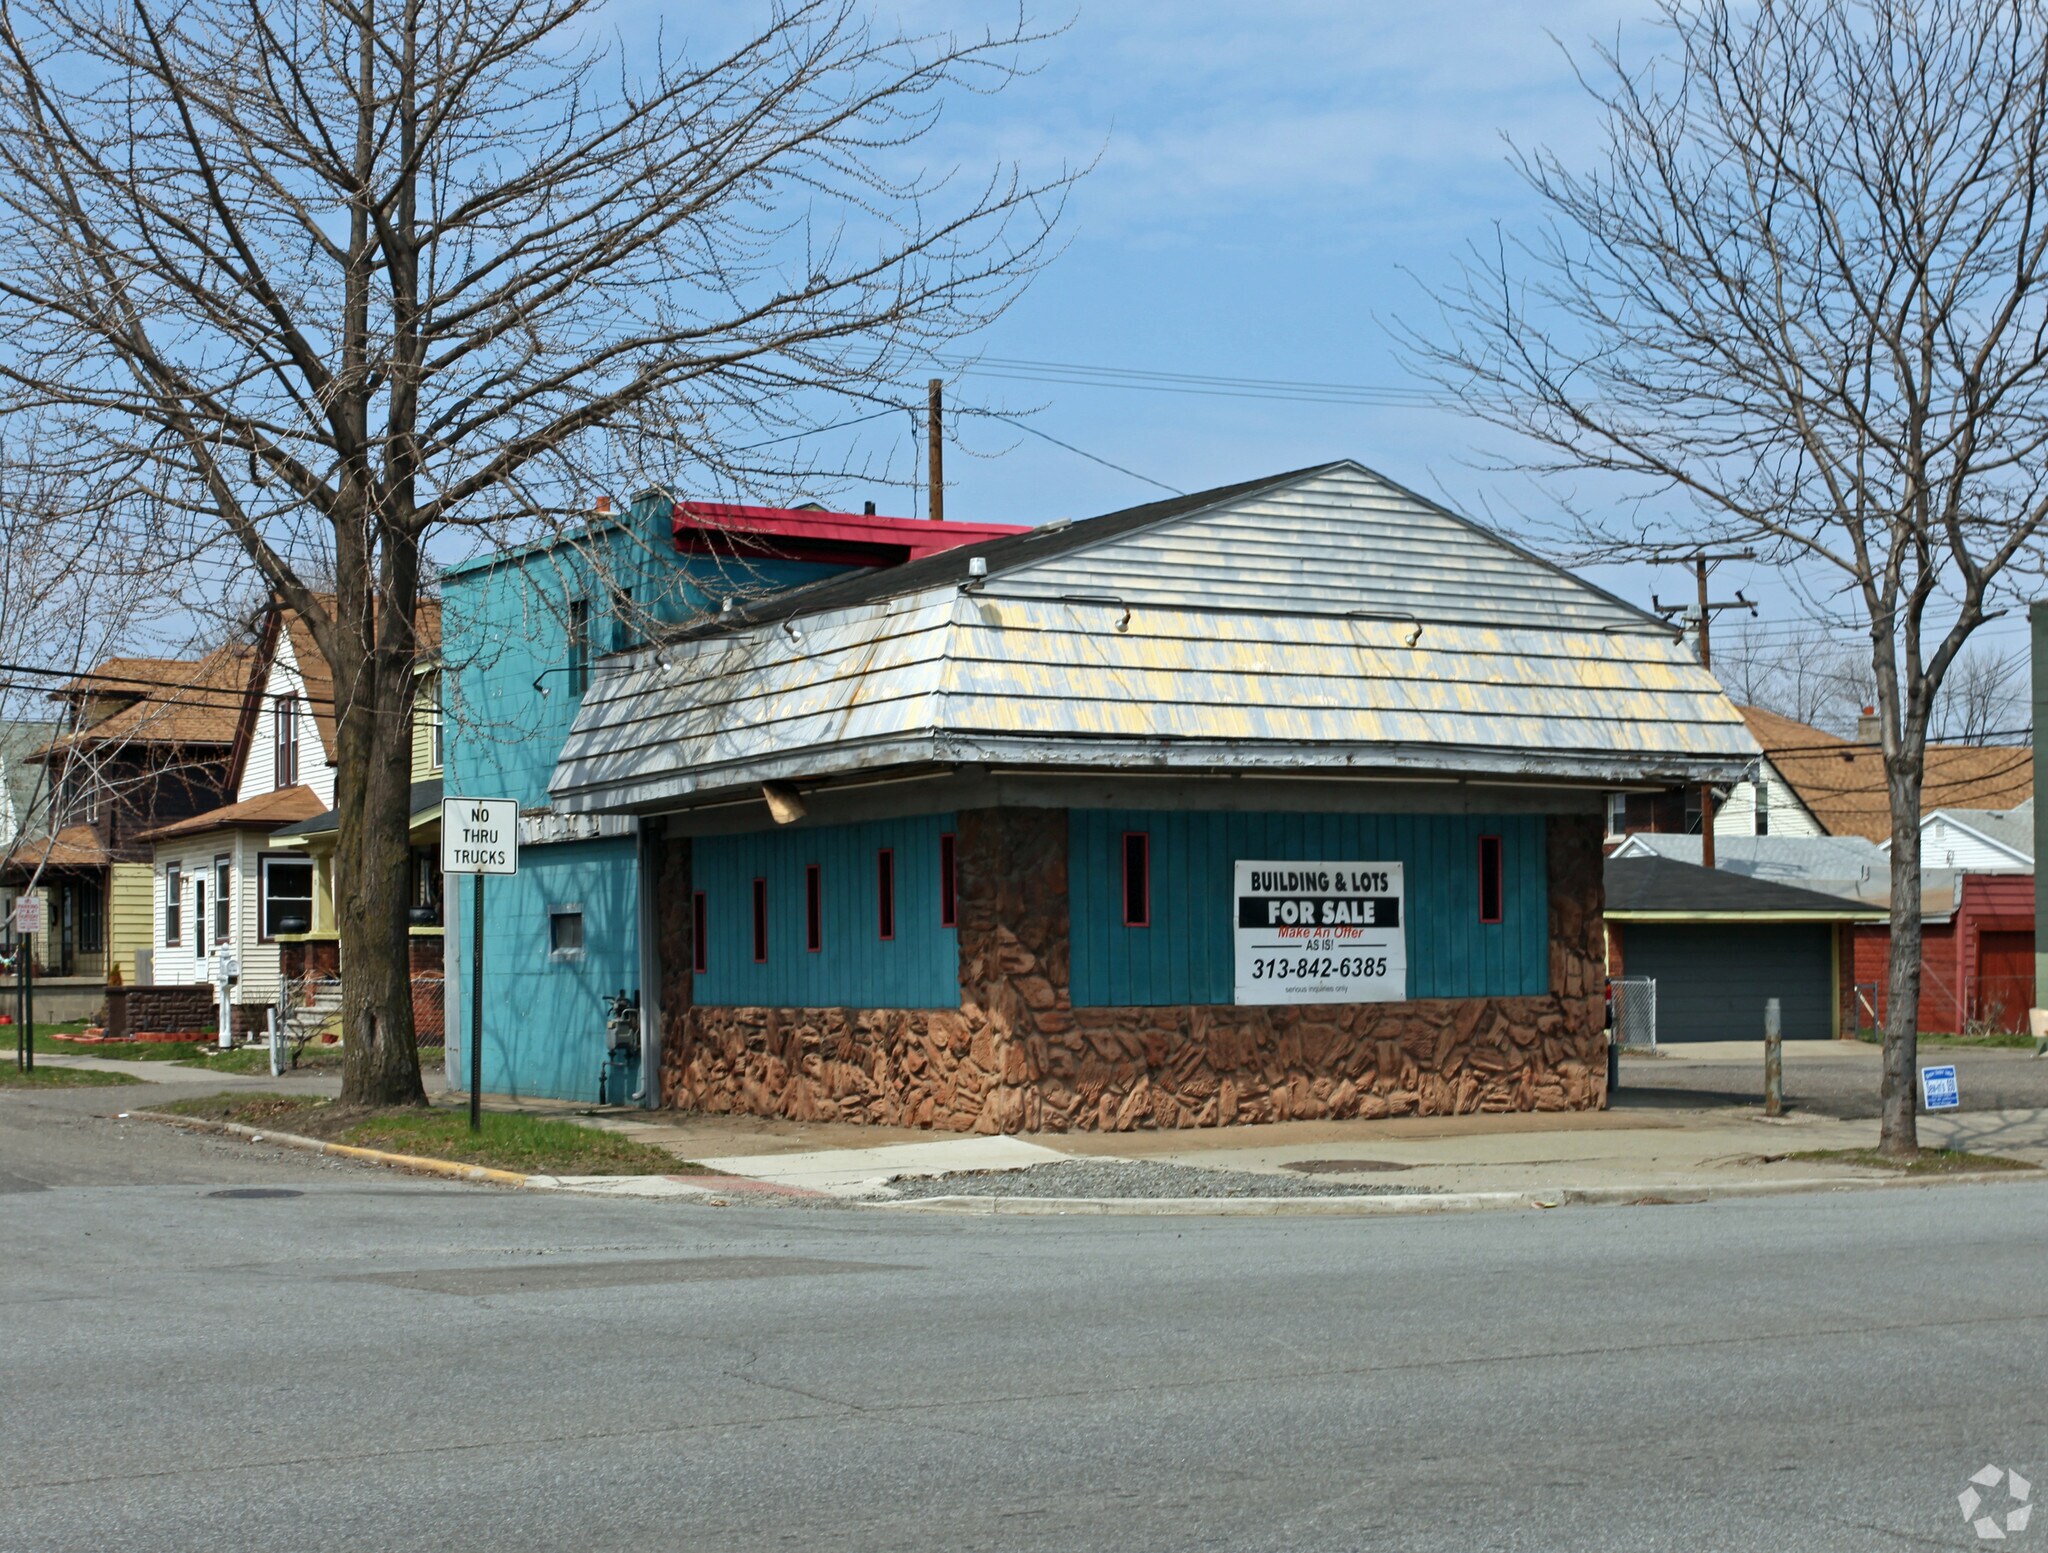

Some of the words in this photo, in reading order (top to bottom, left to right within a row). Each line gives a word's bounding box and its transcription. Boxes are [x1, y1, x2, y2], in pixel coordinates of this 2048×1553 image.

[471, 808, 489, 822] NO
[463, 829, 498, 843] THRU
[454, 850, 505, 865] TRUCKS
[1251, 872, 1329, 892] BUILDING
[1335, 872, 1347, 892] &
[1352, 872, 1388, 892] LOTS
[1268, 901, 1315, 924] FOR
[1322, 901, 1375, 924] SALE
[1278, 926, 1310, 938] Make
[1313, 926, 1330, 938] An
[1334, 926, 1364, 938] Offer
[1306, 939, 1319, 951] AS
[1322, 939, 1334, 951] IS!
[1252, 957, 1387, 979] 313-842-6385
[1335, 984, 1348, 993] only
